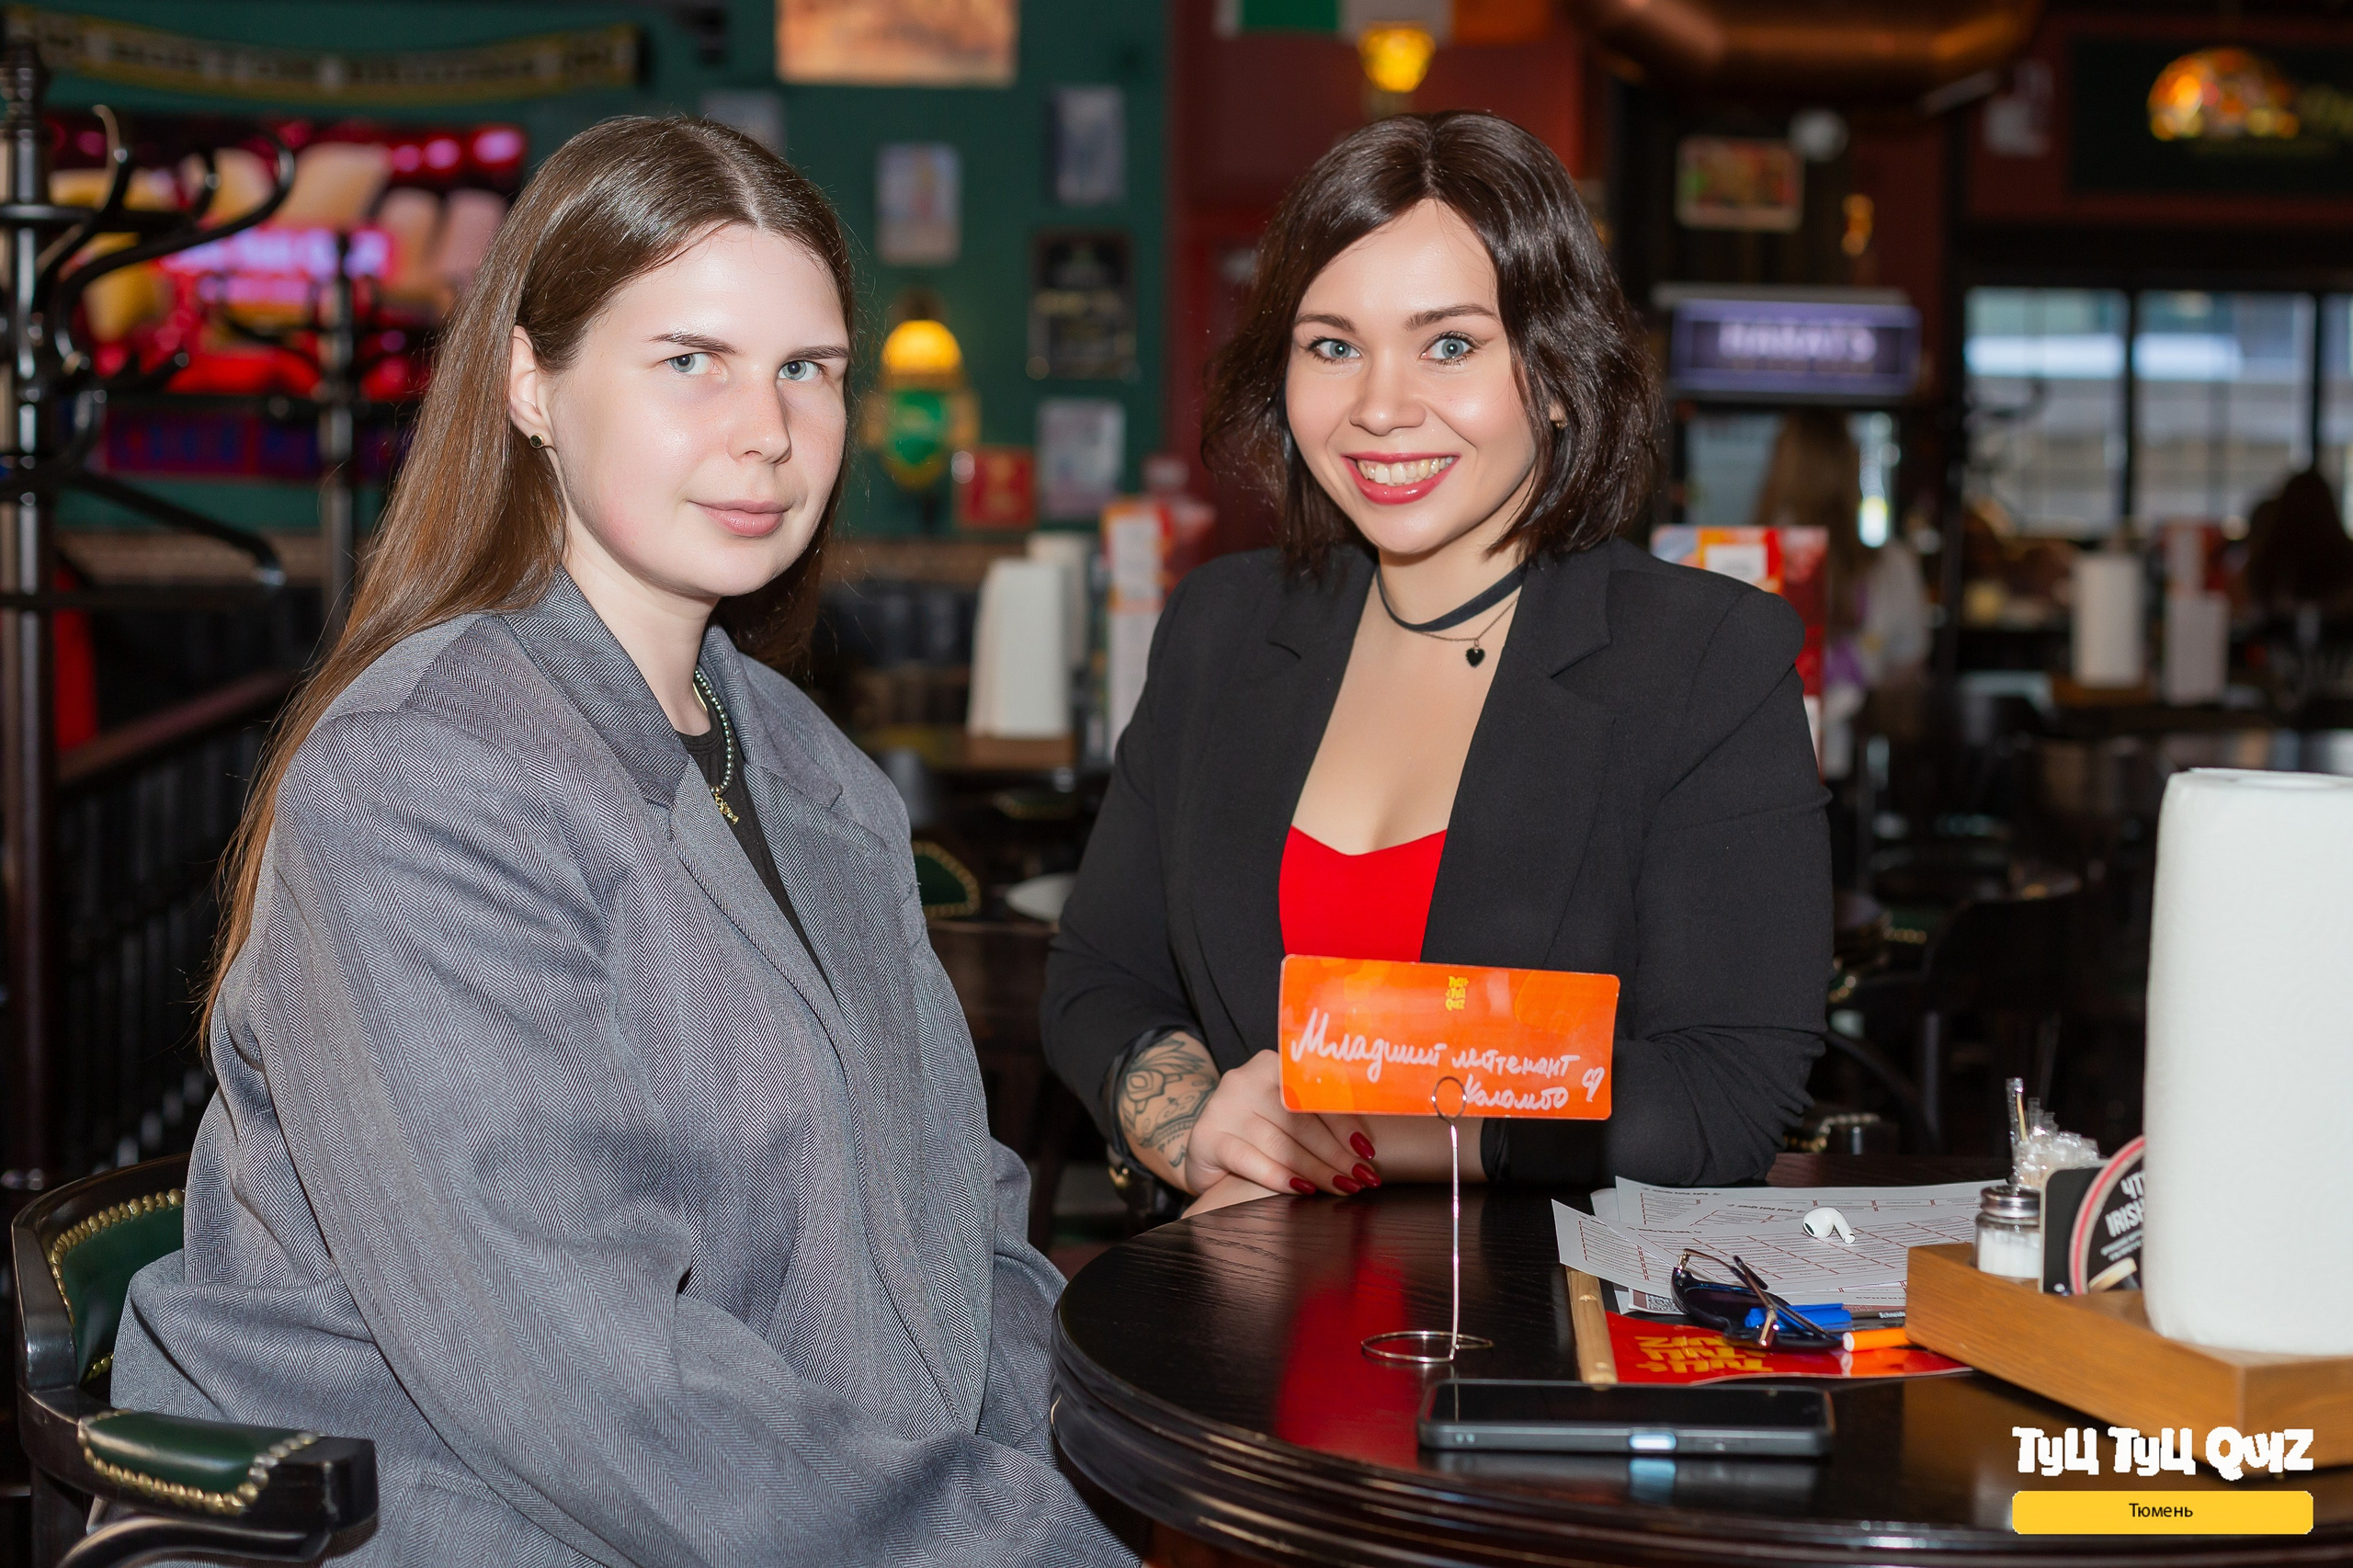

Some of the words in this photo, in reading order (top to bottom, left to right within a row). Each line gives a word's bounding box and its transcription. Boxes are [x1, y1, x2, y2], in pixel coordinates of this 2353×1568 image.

[1290, 1007, 1448, 1083] Младший
[1451, 1047, 1580, 1079] лейтенант
[2120, 1171, 2145, 1199] ЧТ
[1878, 1311, 1906, 1319] Schneide
